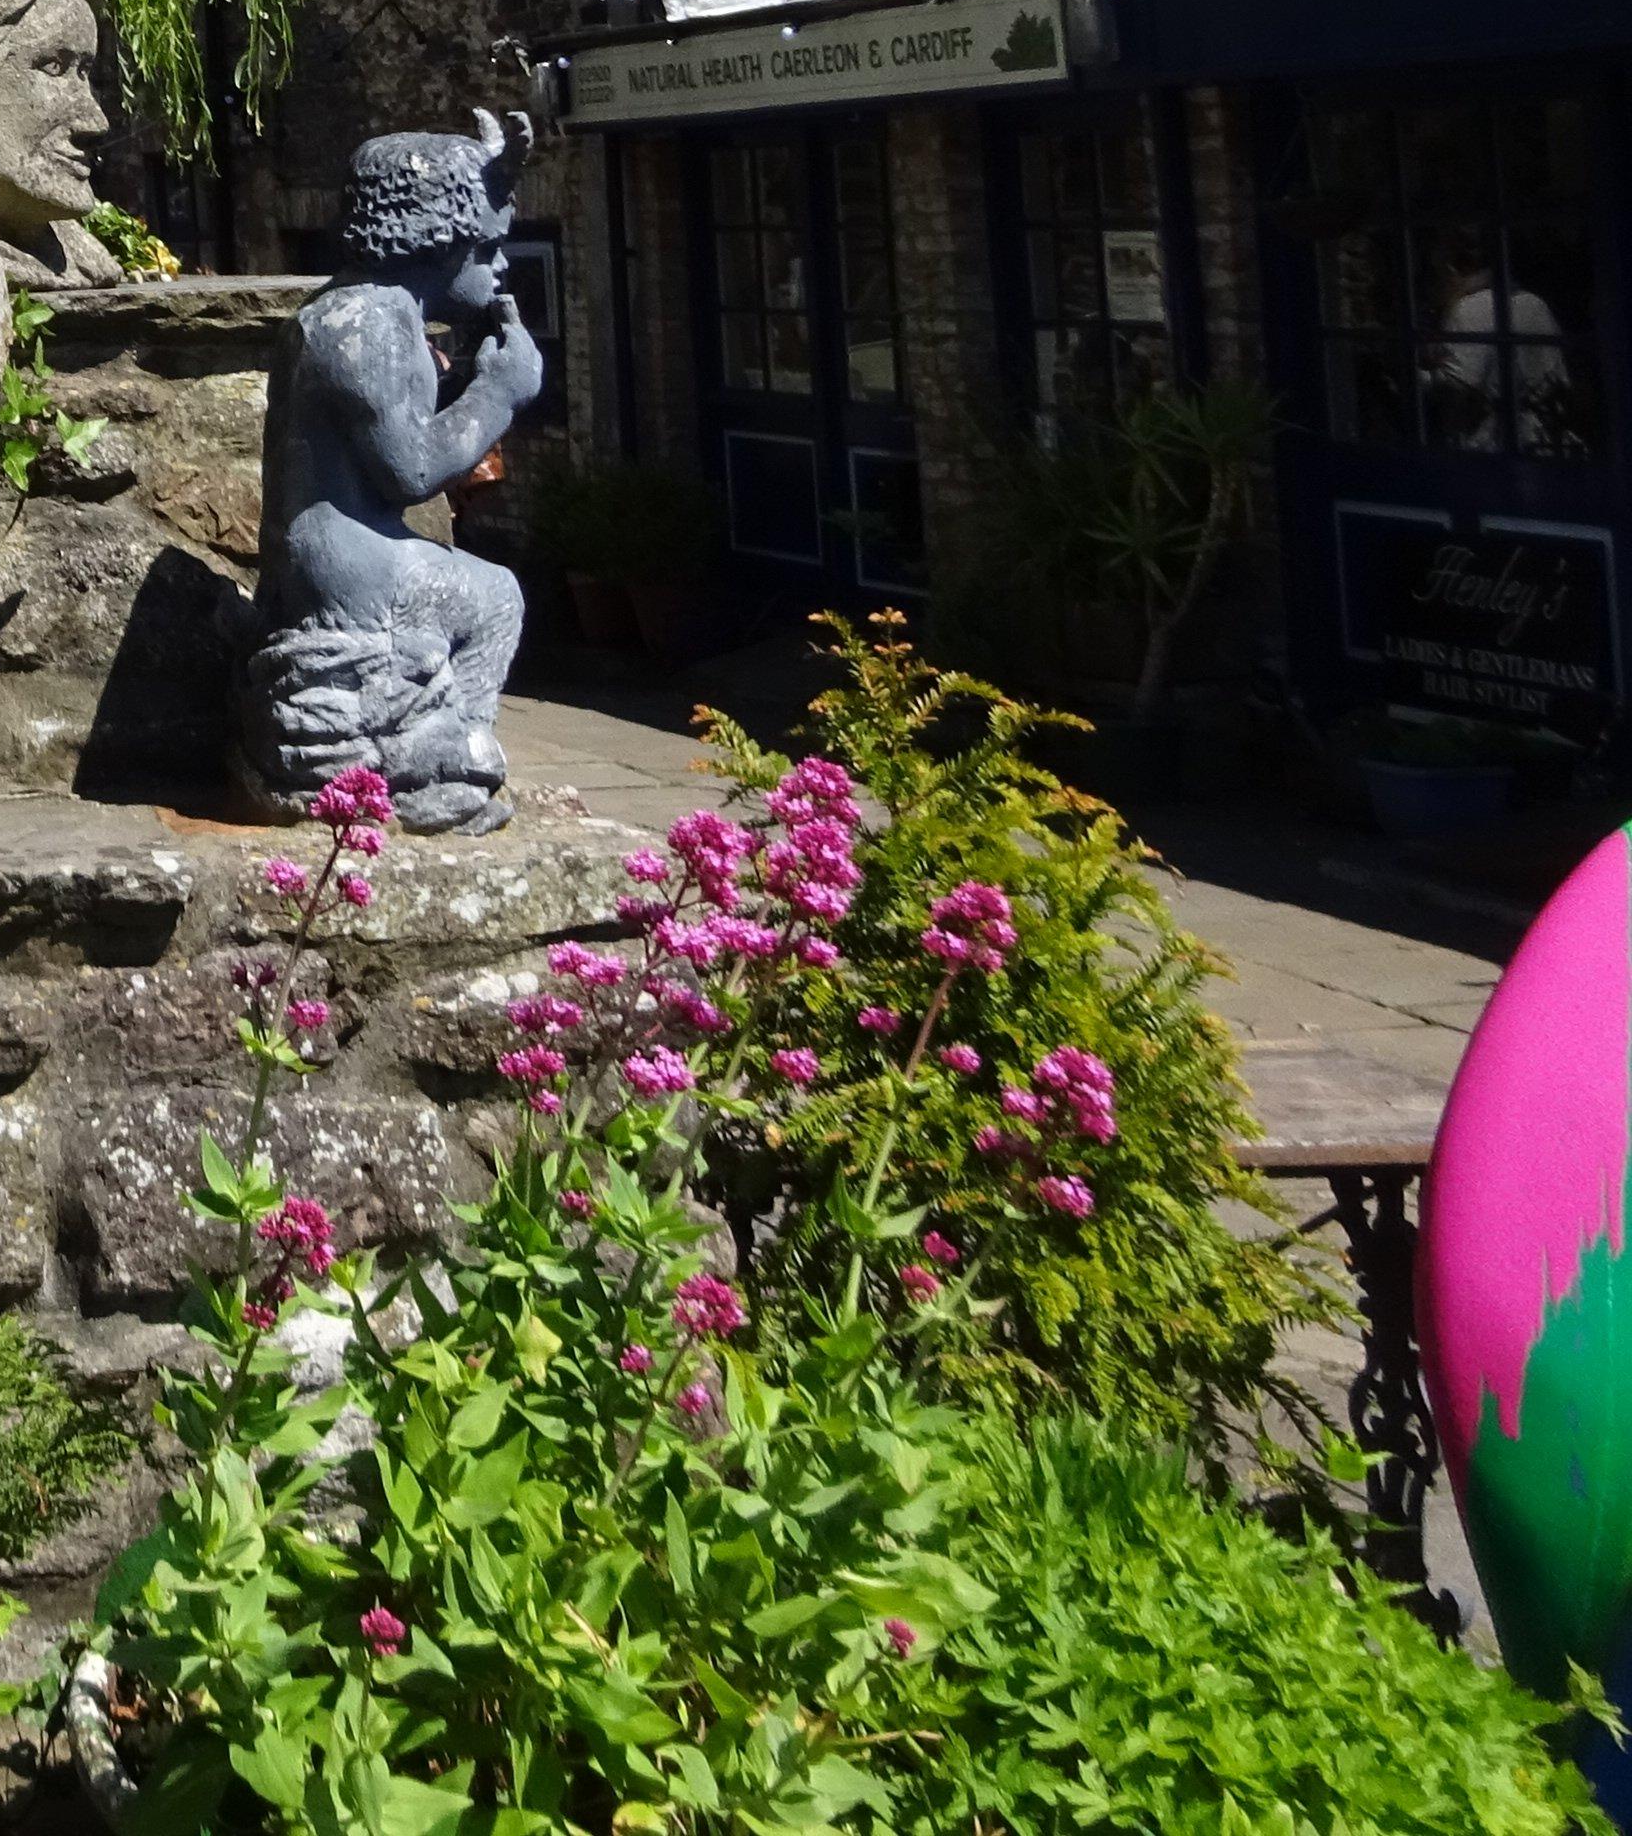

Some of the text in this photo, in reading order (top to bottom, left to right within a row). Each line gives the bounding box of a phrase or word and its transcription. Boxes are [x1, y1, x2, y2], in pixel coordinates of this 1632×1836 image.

[628, 26, 974, 93] NATURAL HEALTH CAERLEON & CARDIFF
[1422, 670, 1470, 703] HAIR
